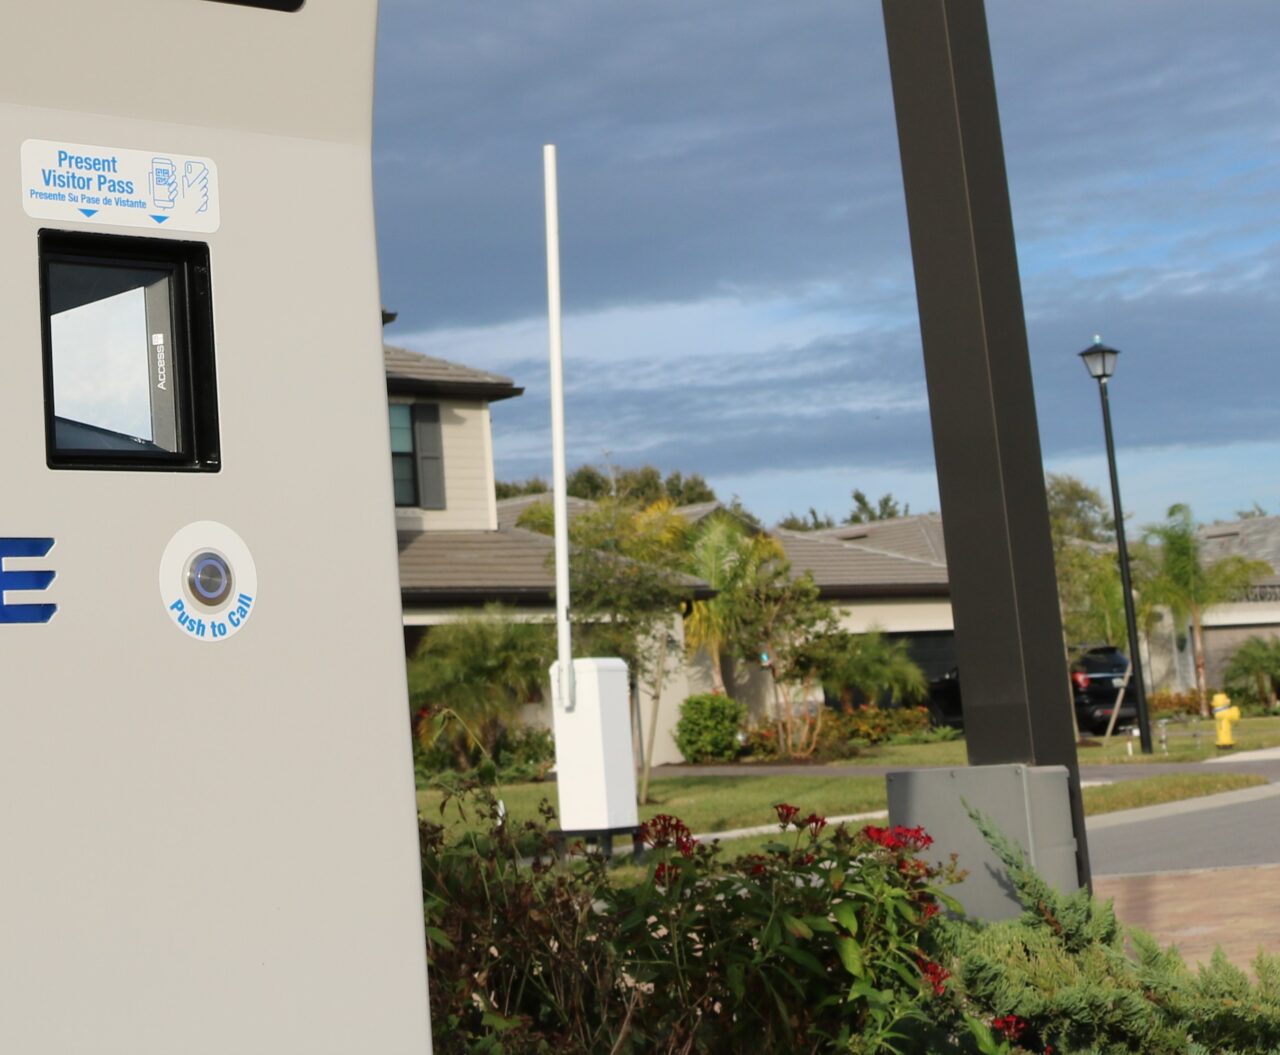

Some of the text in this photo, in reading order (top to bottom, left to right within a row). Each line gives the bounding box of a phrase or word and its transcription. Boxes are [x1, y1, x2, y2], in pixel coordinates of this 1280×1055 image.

[58, 150, 118, 173] Present
[42, 169, 134, 195] Visitor Pass
[30, 189, 66, 202] Presente
[68, 193, 79, 203] Su
[80, 195, 100, 205] Pase
[102, 196, 113, 206] de
[169, 593, 253, 638] Push to Call
